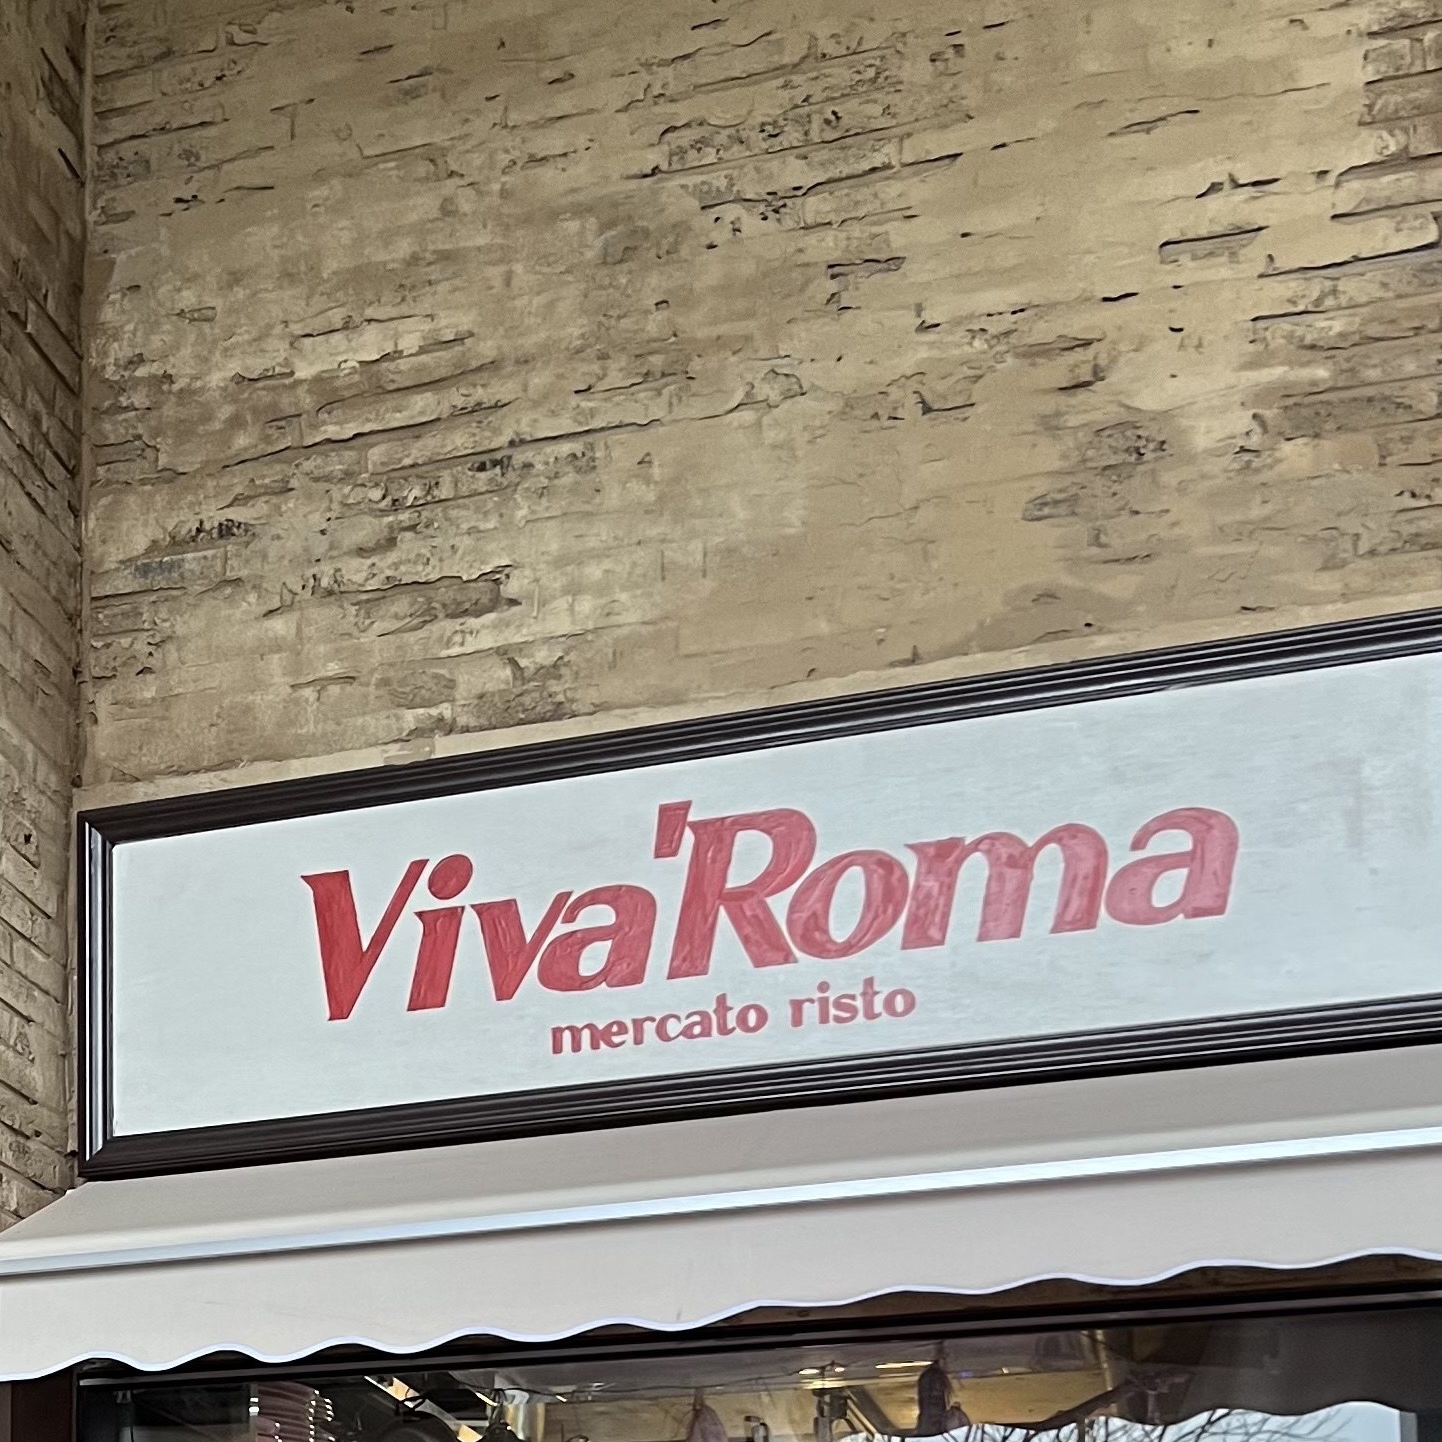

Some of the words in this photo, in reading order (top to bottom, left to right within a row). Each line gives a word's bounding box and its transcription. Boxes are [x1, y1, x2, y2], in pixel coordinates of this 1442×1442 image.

[302, 802, 1238, 1022] Viva'Roma
[551, 997, 768, 1055] mercato
[788, 979, 917, 1028] risto
